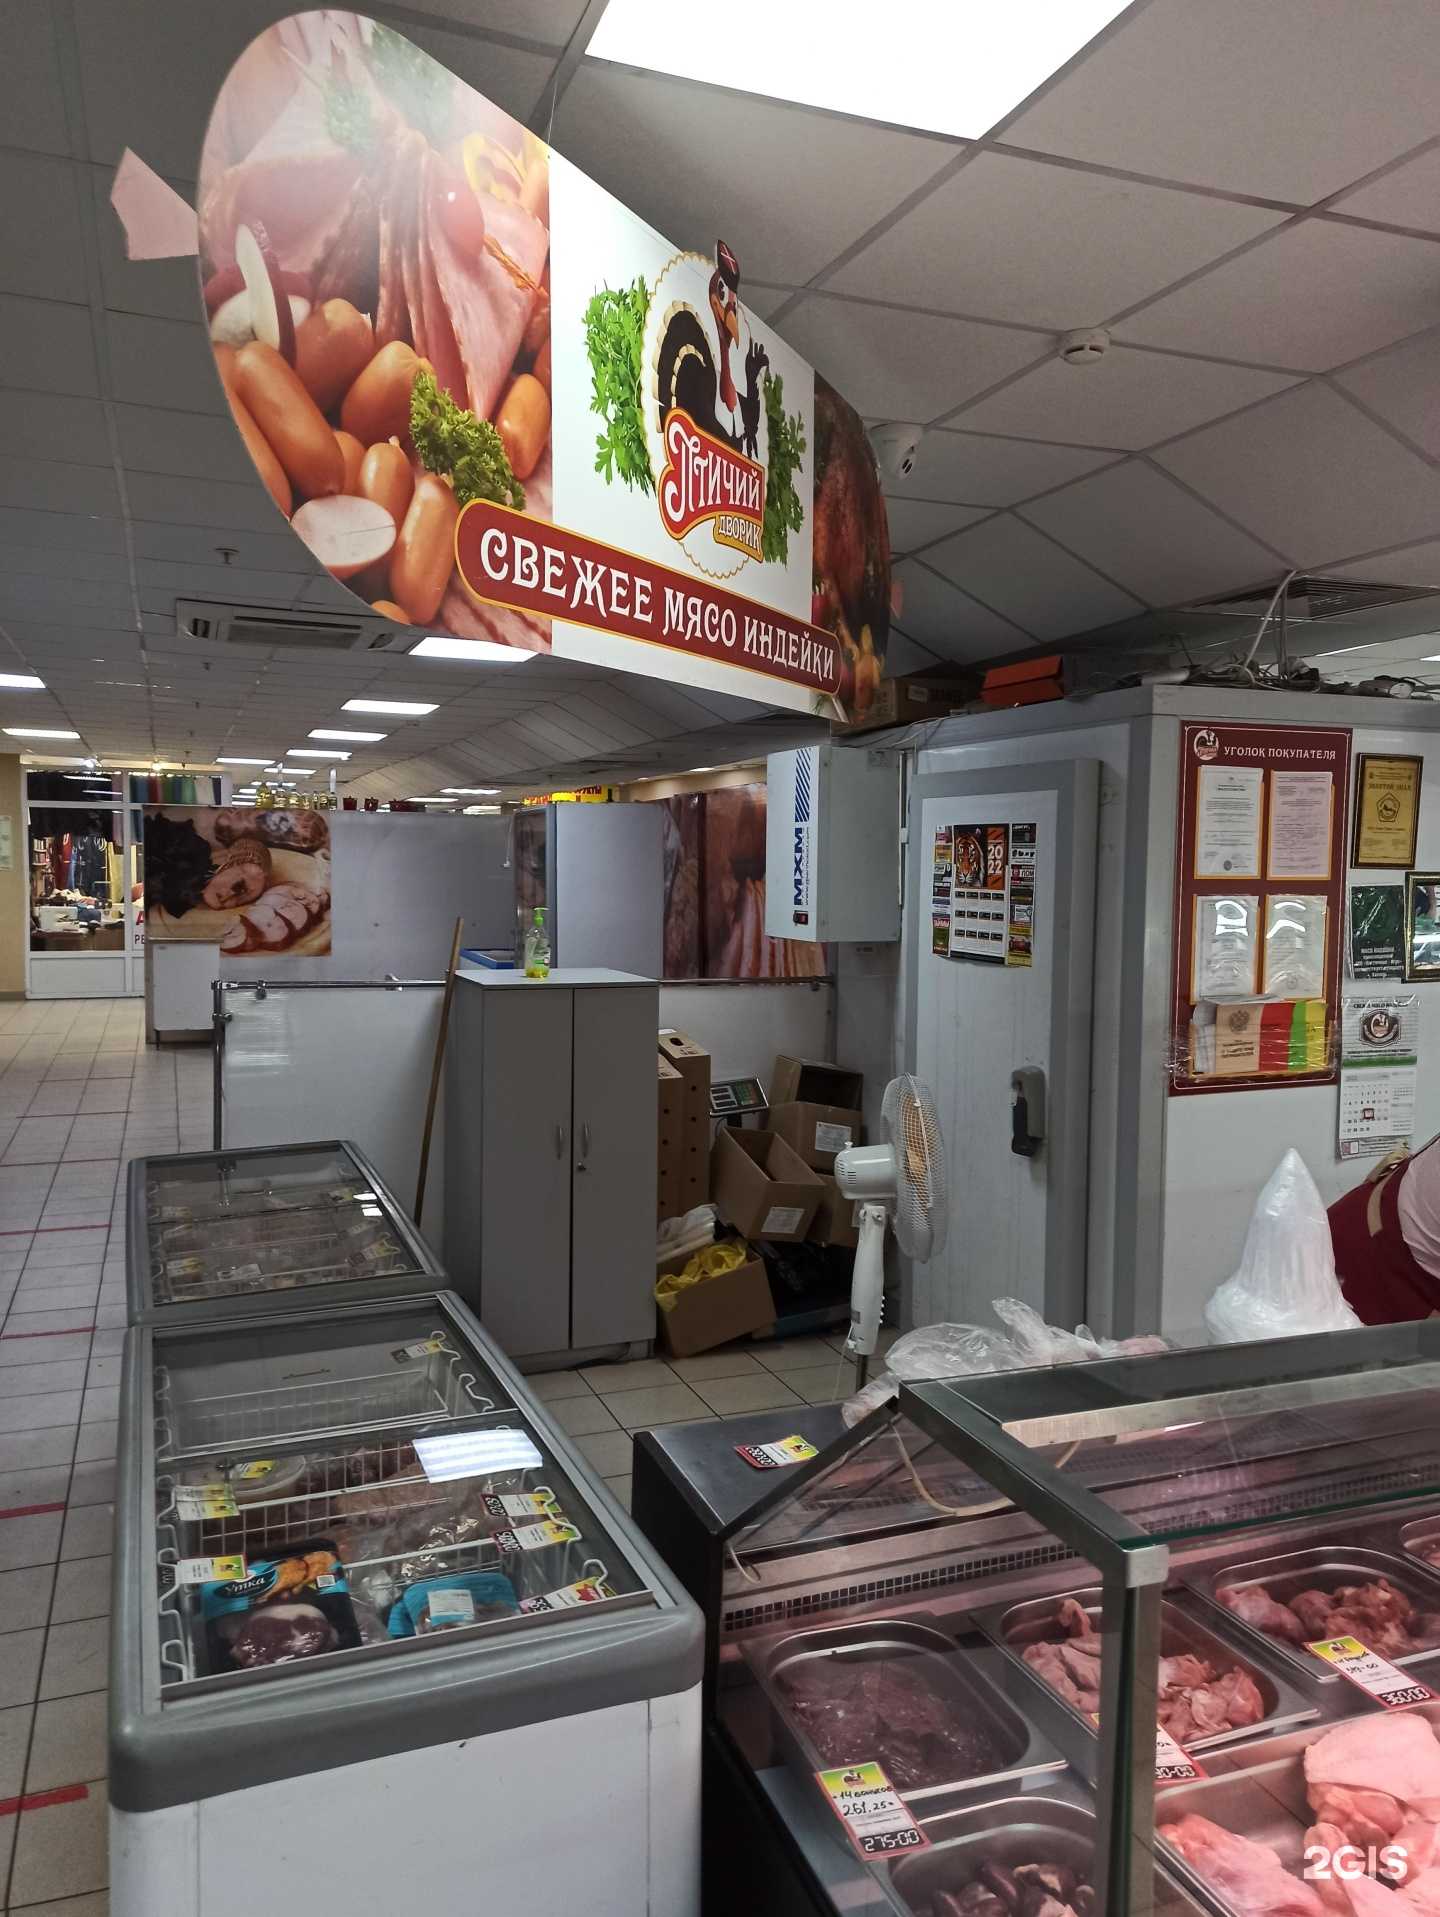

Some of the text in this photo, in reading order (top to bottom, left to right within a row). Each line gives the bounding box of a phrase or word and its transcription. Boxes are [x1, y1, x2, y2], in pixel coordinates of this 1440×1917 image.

[664, 421, 761, 523] ПТИЧИЙ
[718, 515, 762, 555] ДВОРИК
[479, 527, 835, 683] СВЕЖЕЕ МЯСО ИНДЕЙКИ
[1223, 746, 1266, 758] УГОЛОК
[1268, 748, 1337, 761] ПОКУПАТЕЛЯ
[793, 827, 803, 906] MXM
[987, 845, 1004, 860] 20
[987, 859, 1003, 875] 22
